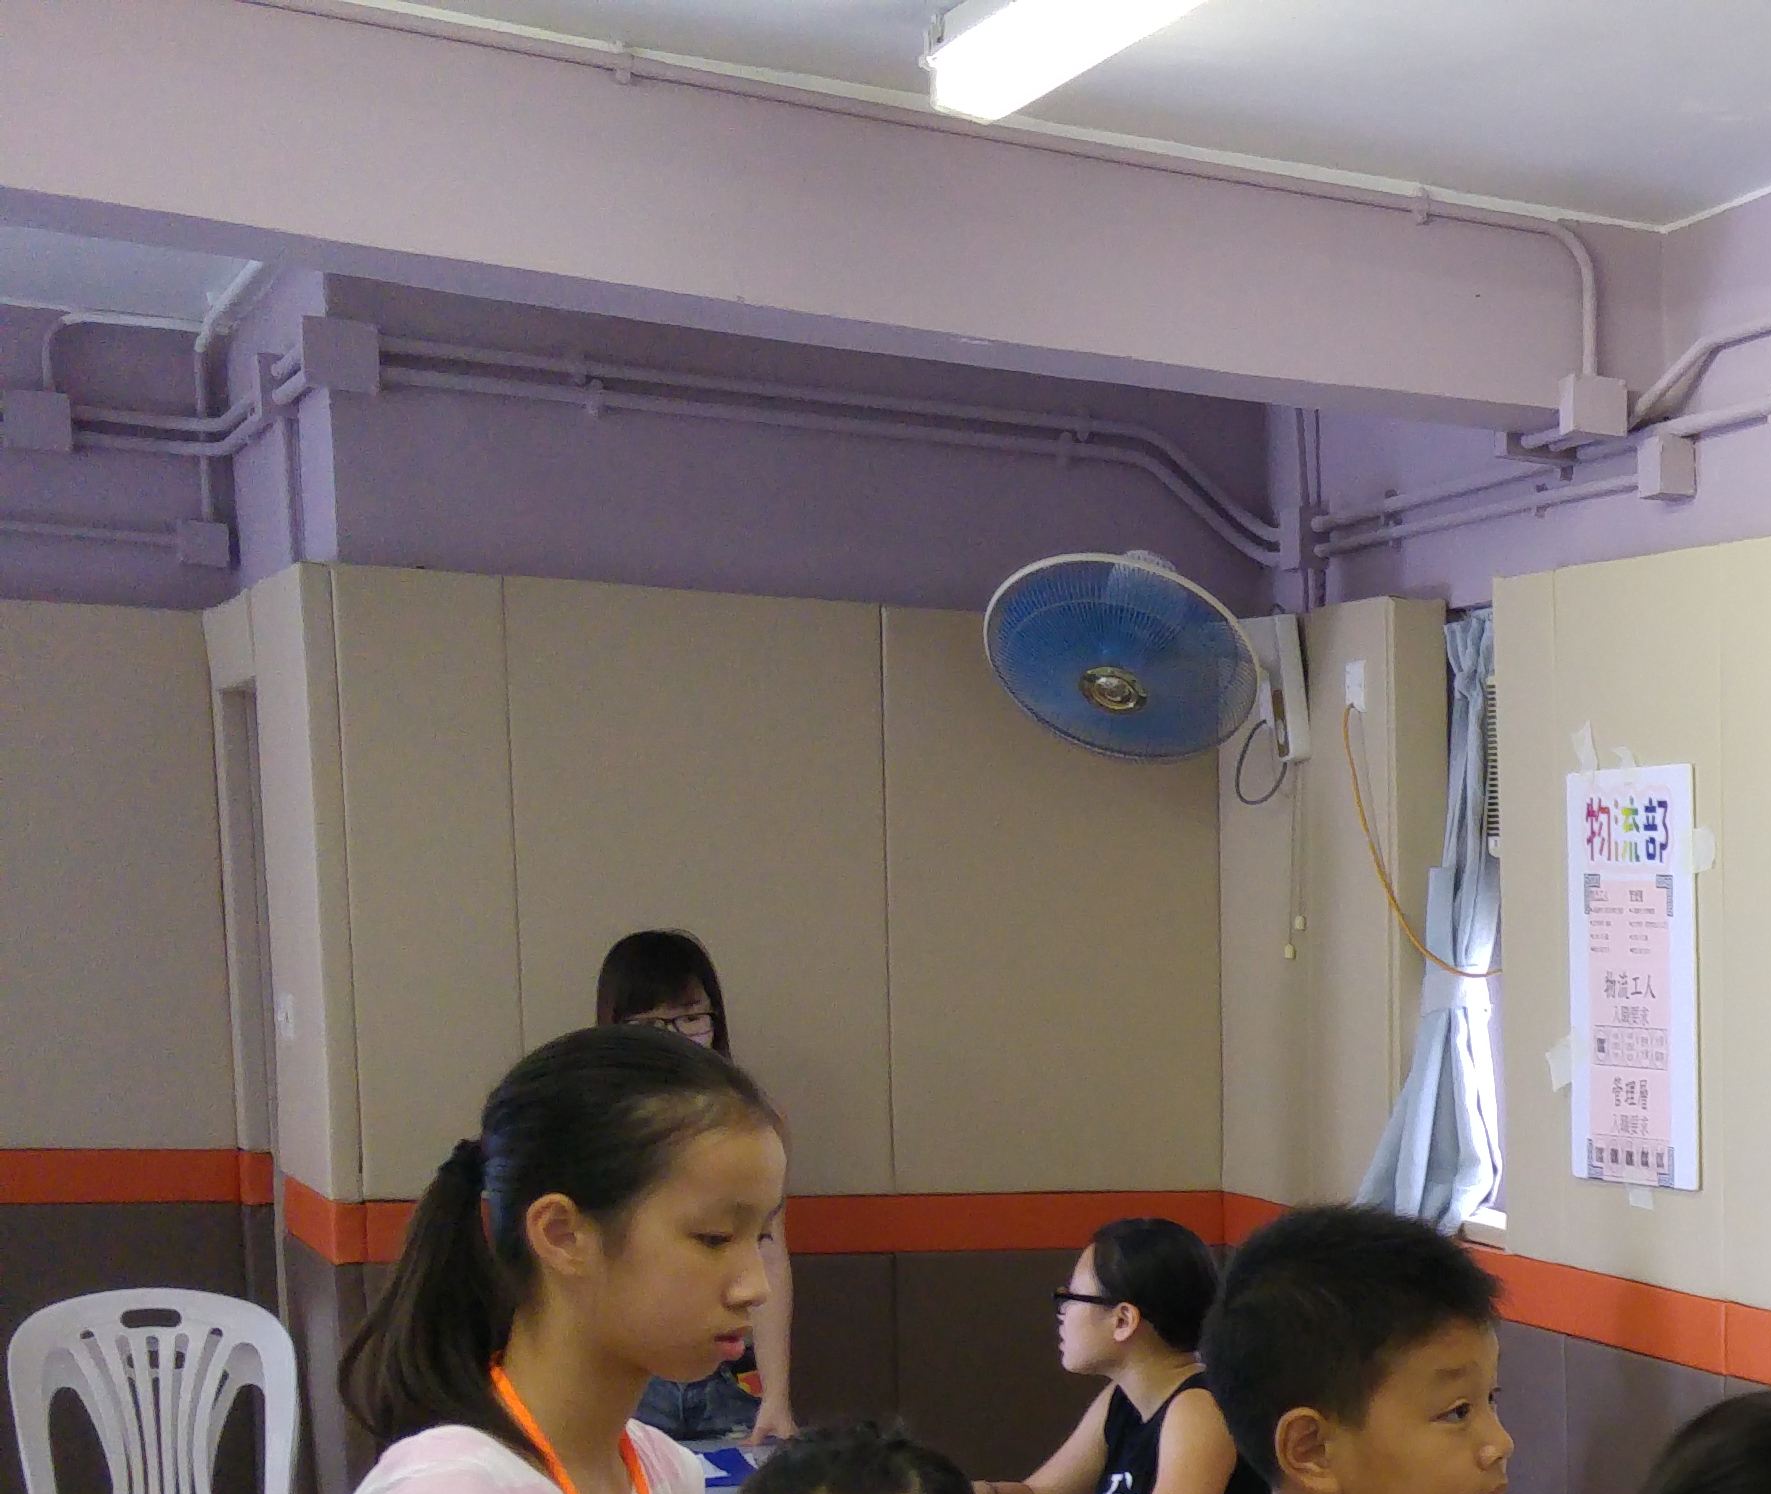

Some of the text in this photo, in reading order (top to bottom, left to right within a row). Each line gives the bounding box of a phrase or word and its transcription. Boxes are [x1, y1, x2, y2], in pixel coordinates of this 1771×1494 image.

[1586, 795, 1668, 863] 物流部
[1604, 970, 1656, 999] 物流工人
